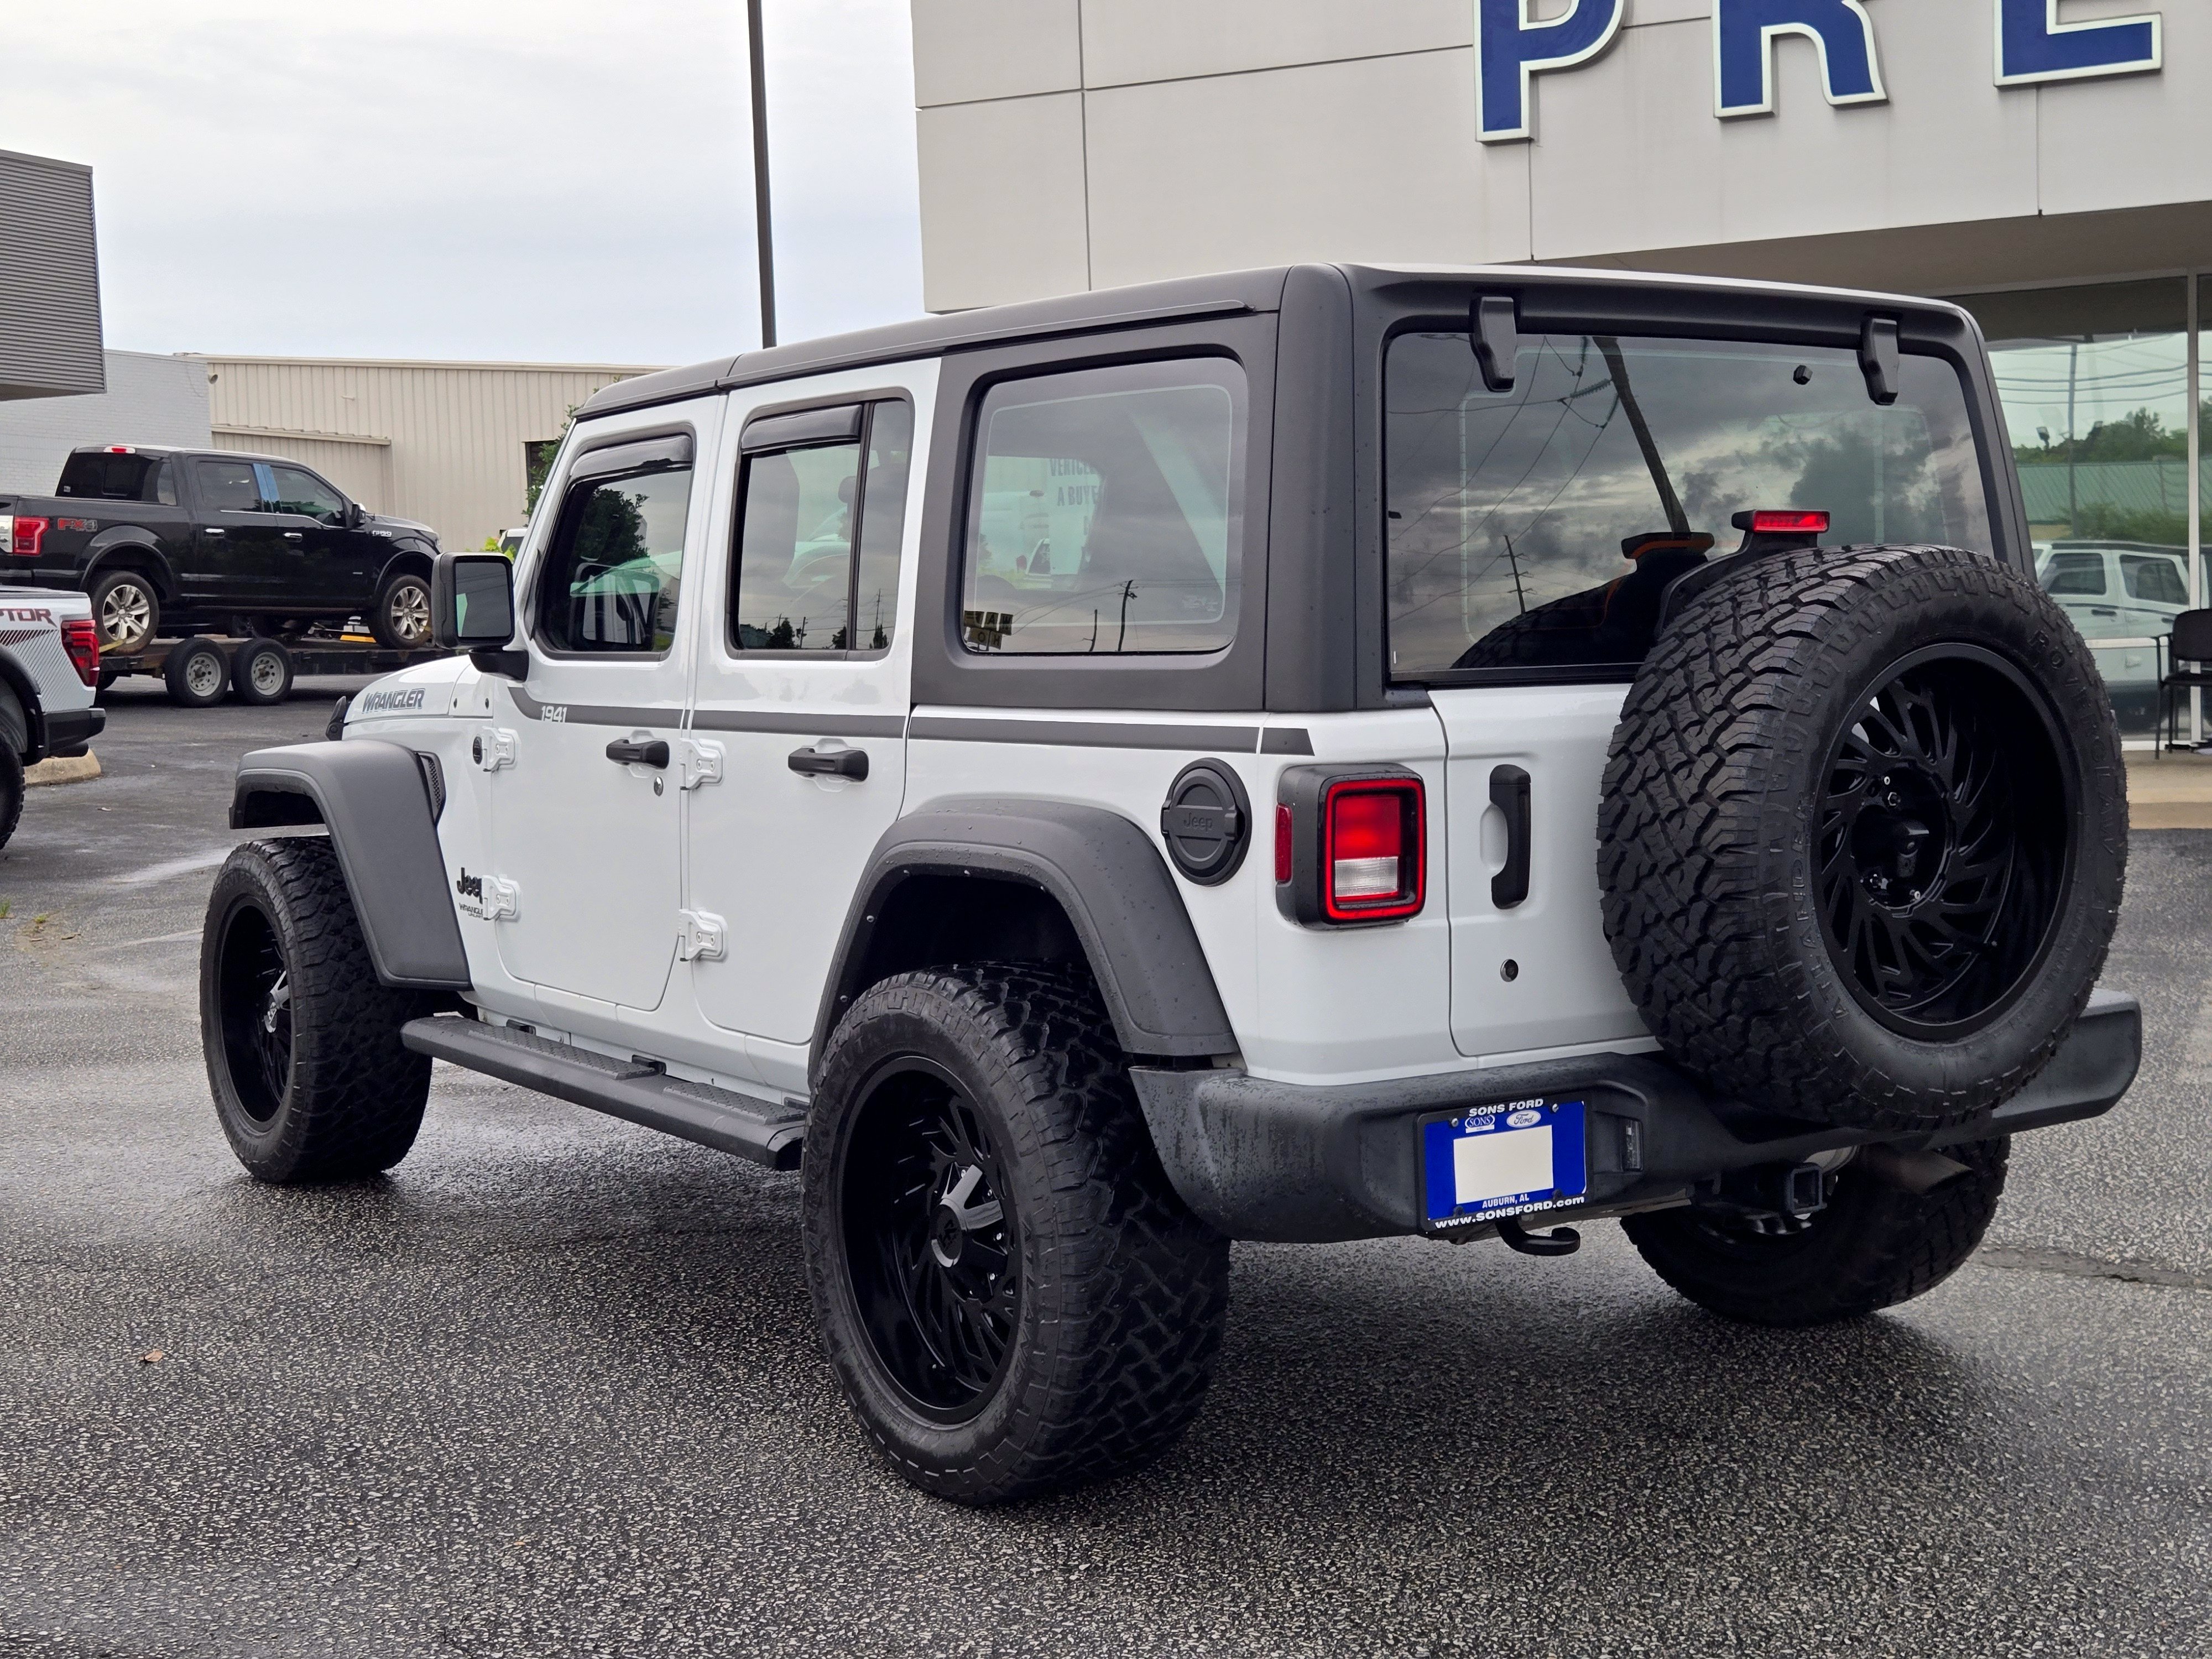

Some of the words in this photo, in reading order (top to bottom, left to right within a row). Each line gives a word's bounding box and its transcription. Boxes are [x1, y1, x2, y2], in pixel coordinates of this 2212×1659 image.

[58, 518, 98, 532] FX4
[361, 688, 426, 714] WRANGLER
[541, 705, 567, 723] 1941
[1183, 811, 1213, 833] Jeep
[1469, 1105, 1505, 1117] SONS
[1509, 1098, 1543, 1112] FORD
[1469, 1116, 1491, 1128] SONS
[1514, 1113, 1533, 1125] Ford
[1482, 1195, 1517, 1209] AUBURN,
[1519, 1193, 1530, 1203] AL
[1434, 1196, 1585, 1229] www.SONSFORD.com
